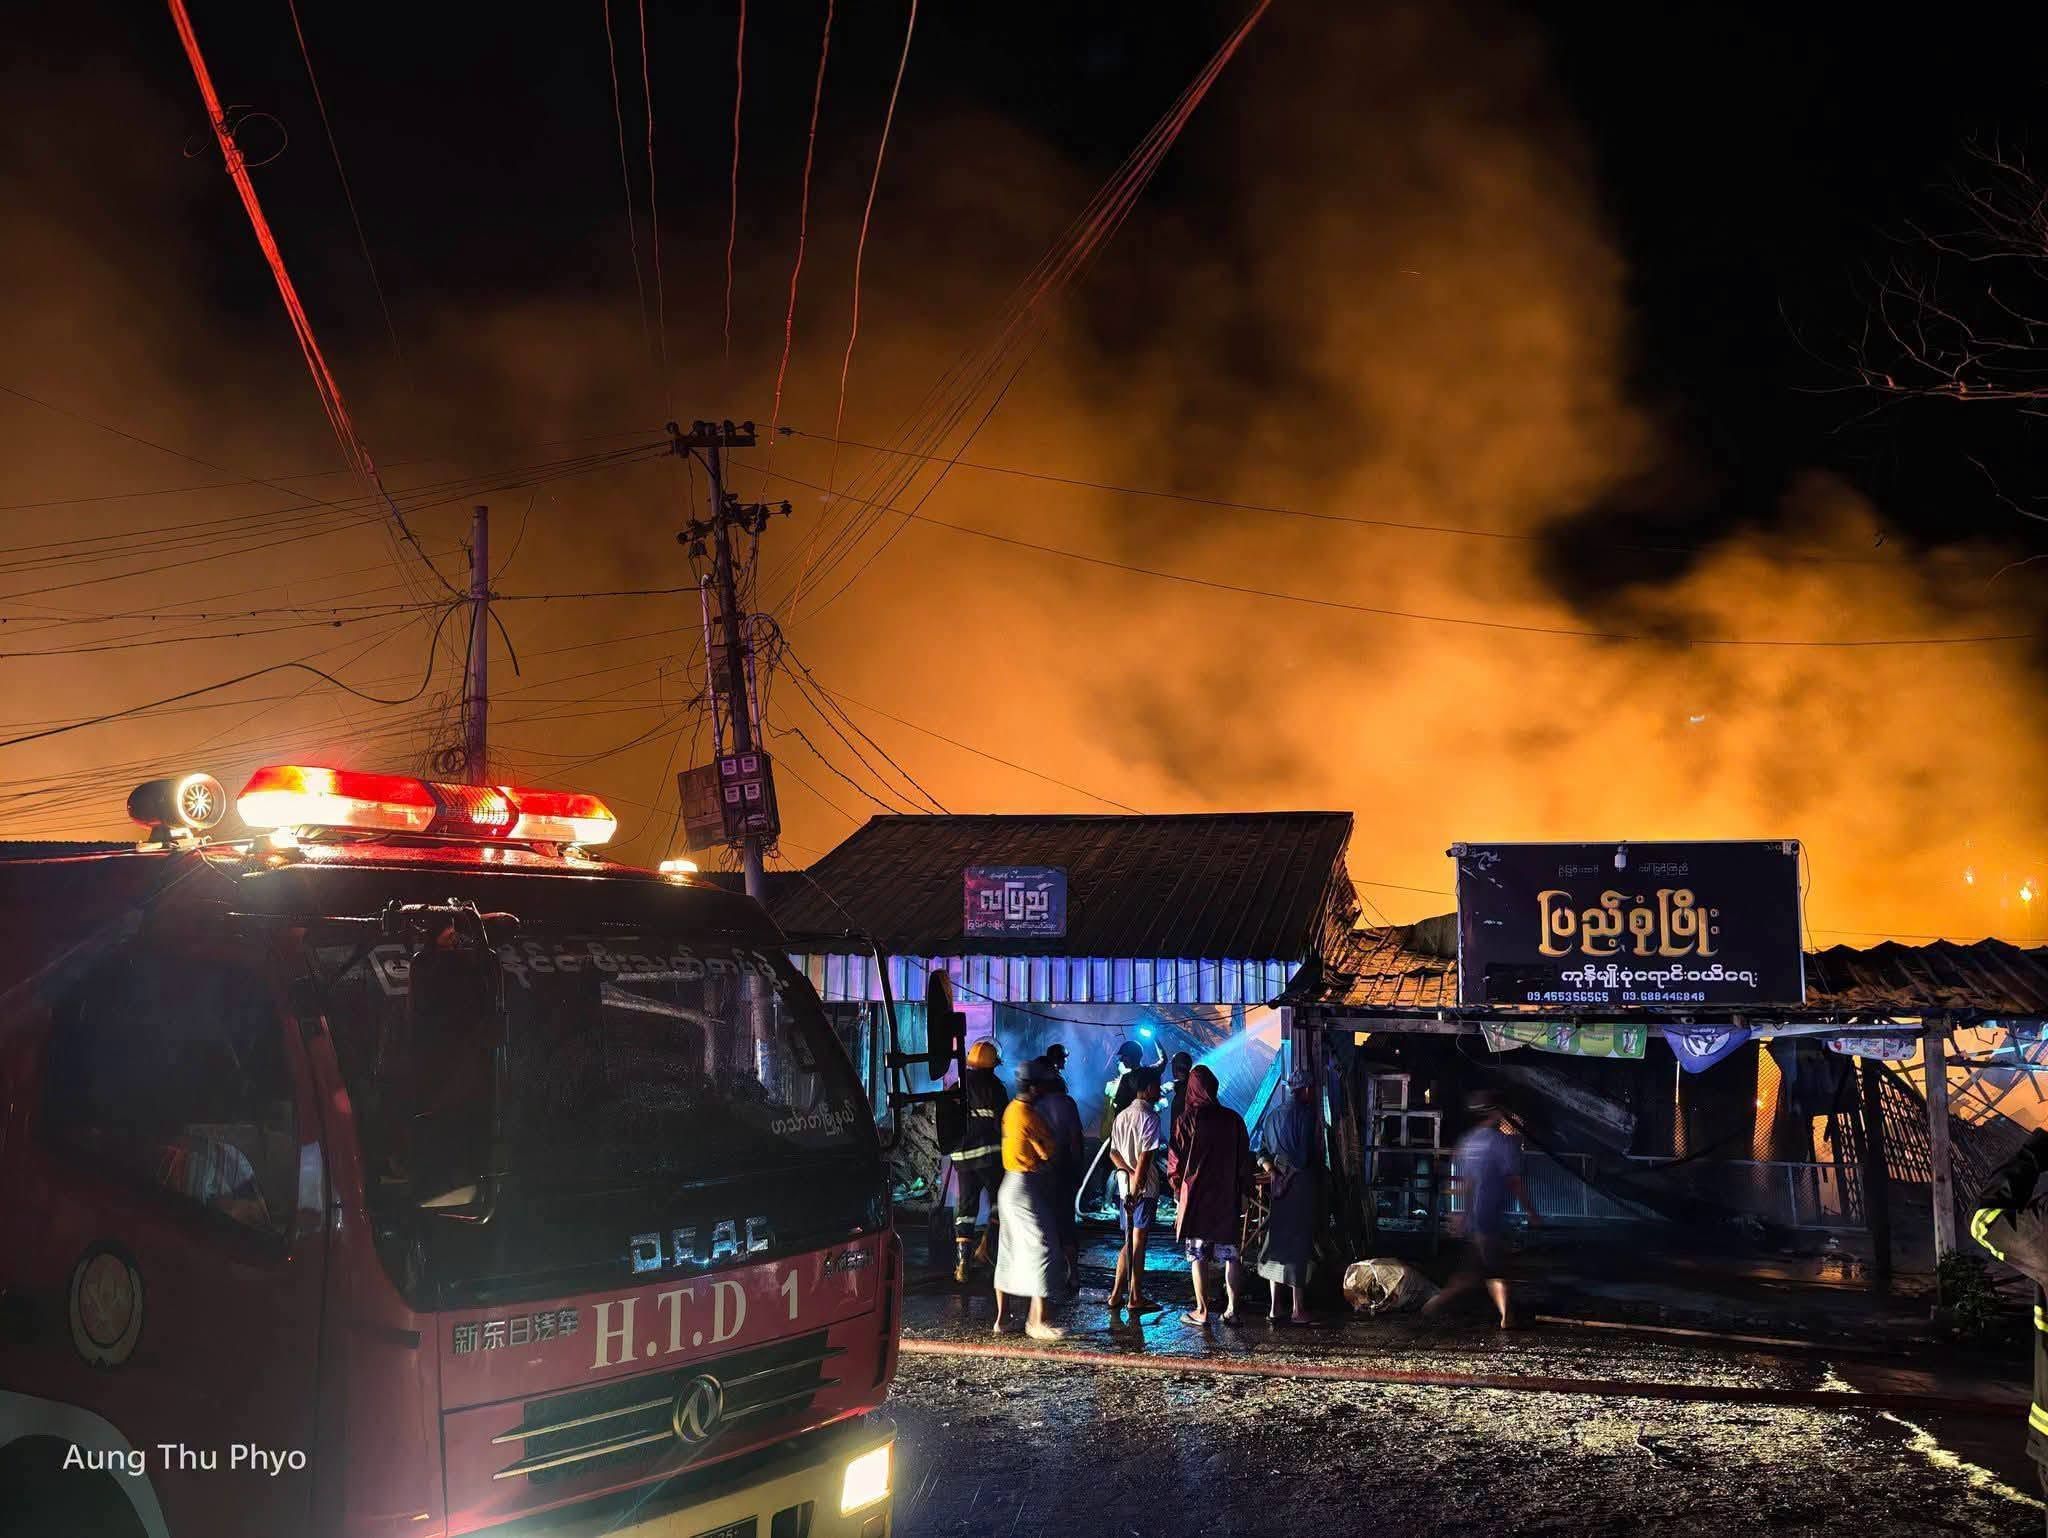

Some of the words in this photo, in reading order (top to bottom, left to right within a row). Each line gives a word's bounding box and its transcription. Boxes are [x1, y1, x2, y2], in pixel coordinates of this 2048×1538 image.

[454, 1308, 580, 1354] 新东日汽车
[590, 1279, 747, 1369] H.T.D
[781, 1269, 799, 1320] 1
